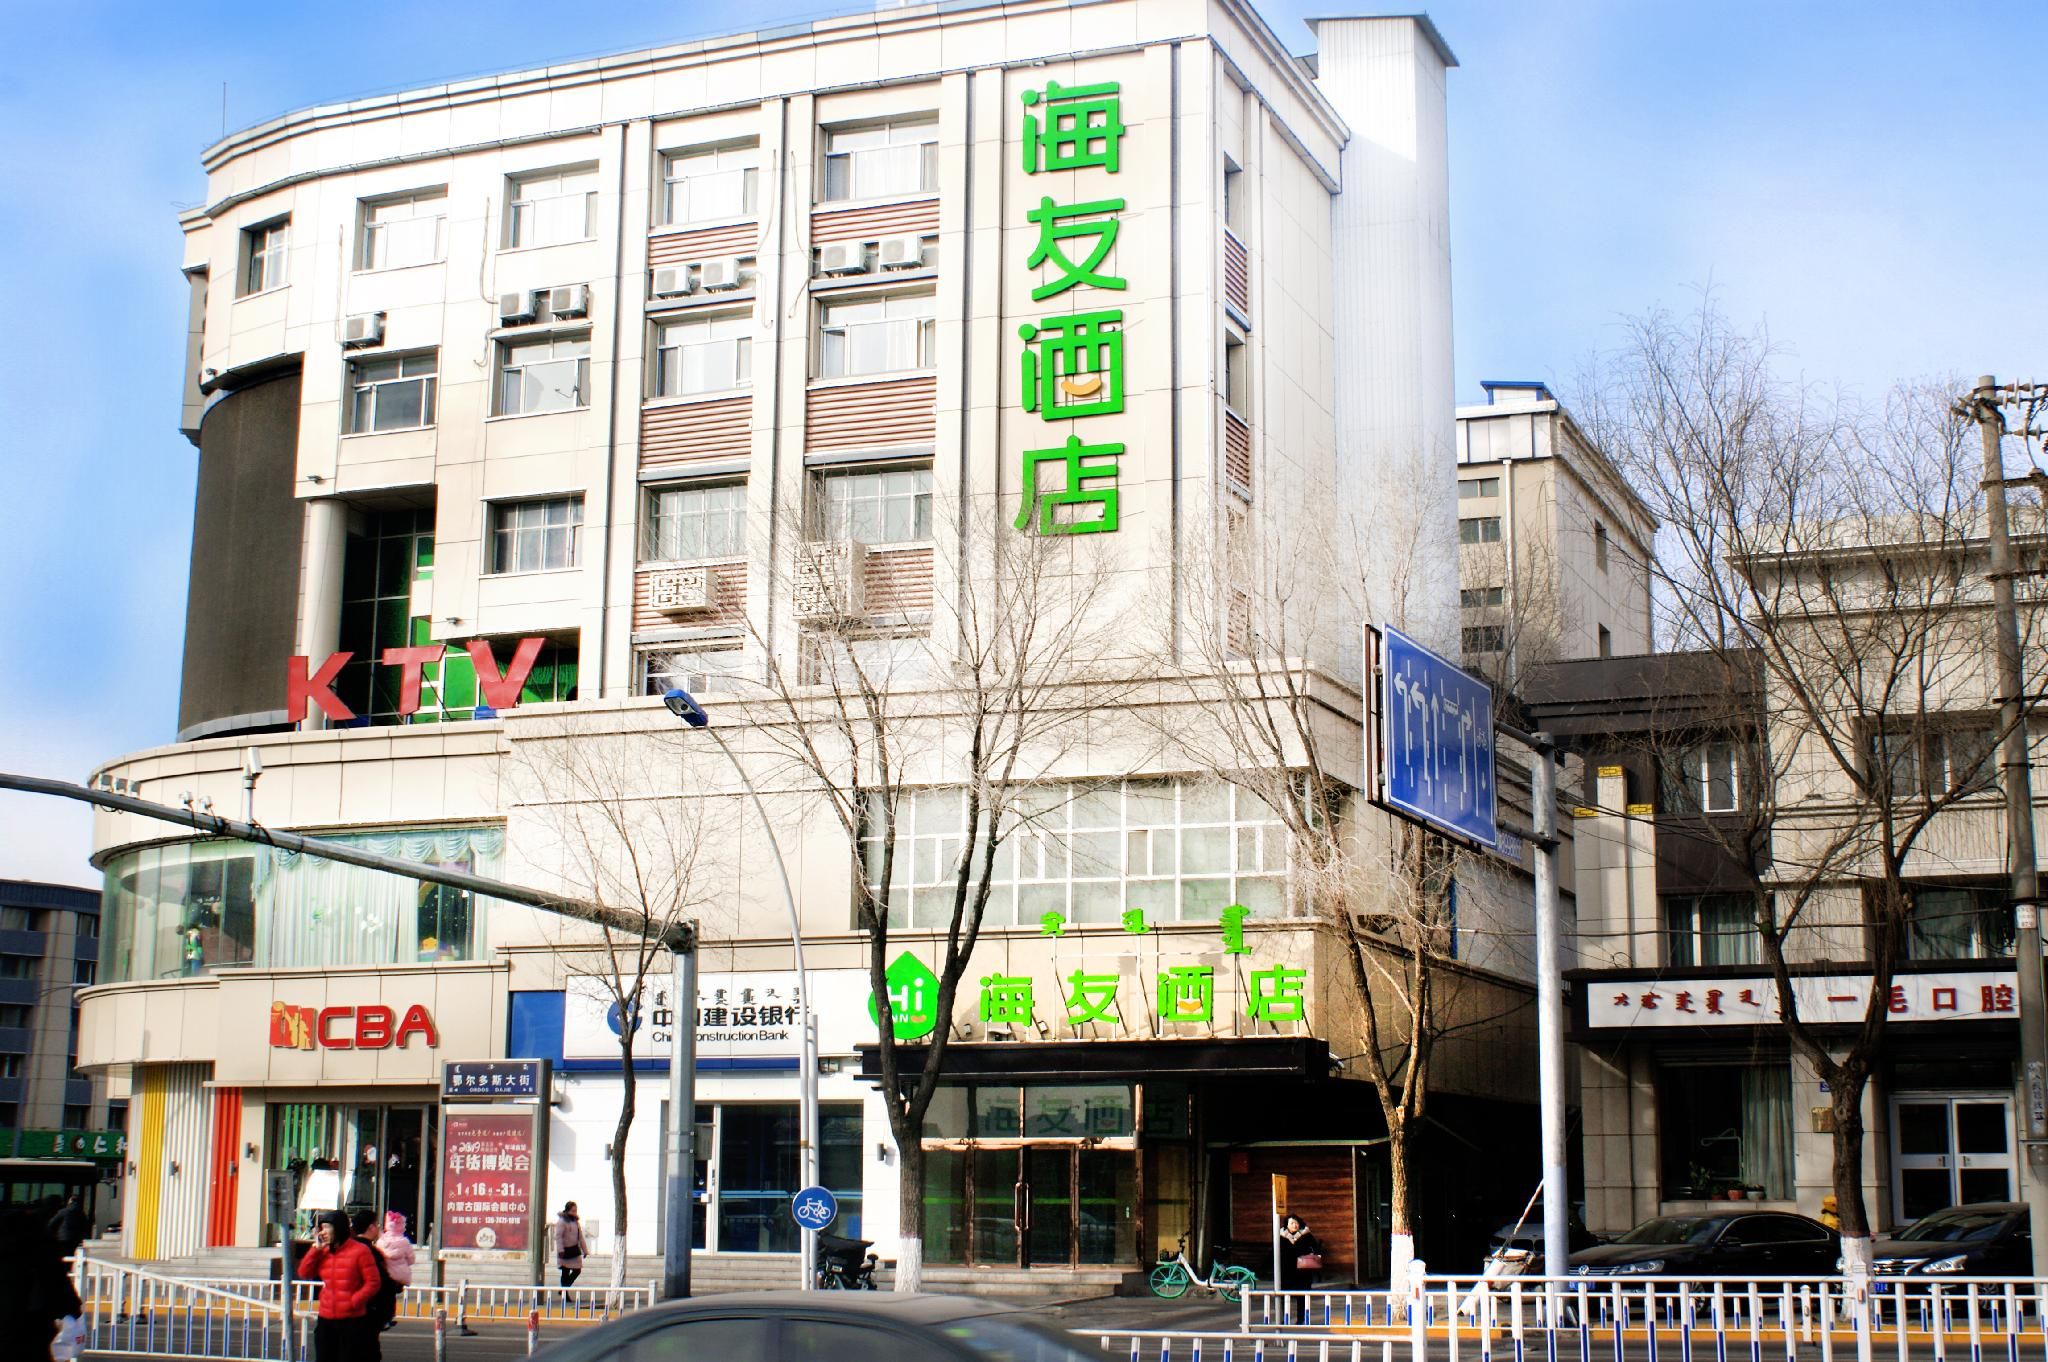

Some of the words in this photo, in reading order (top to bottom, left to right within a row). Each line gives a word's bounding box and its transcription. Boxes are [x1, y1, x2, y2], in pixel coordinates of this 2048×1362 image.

[1014, 80, 1127, 537] 海友酒店
[288, 637, 546, 723] KTV
[887, 977, 924, 1012] Hi
[979, 963, 1307, 1027] 海友酒店
[318, 1004, 438, 1050] CBA
[652, 1004, 810, 1028] 中建设银行
[759, 1030, 789, 1041] Bank
[453, 1074, 530, 1087] 鄂尔多斯大街
